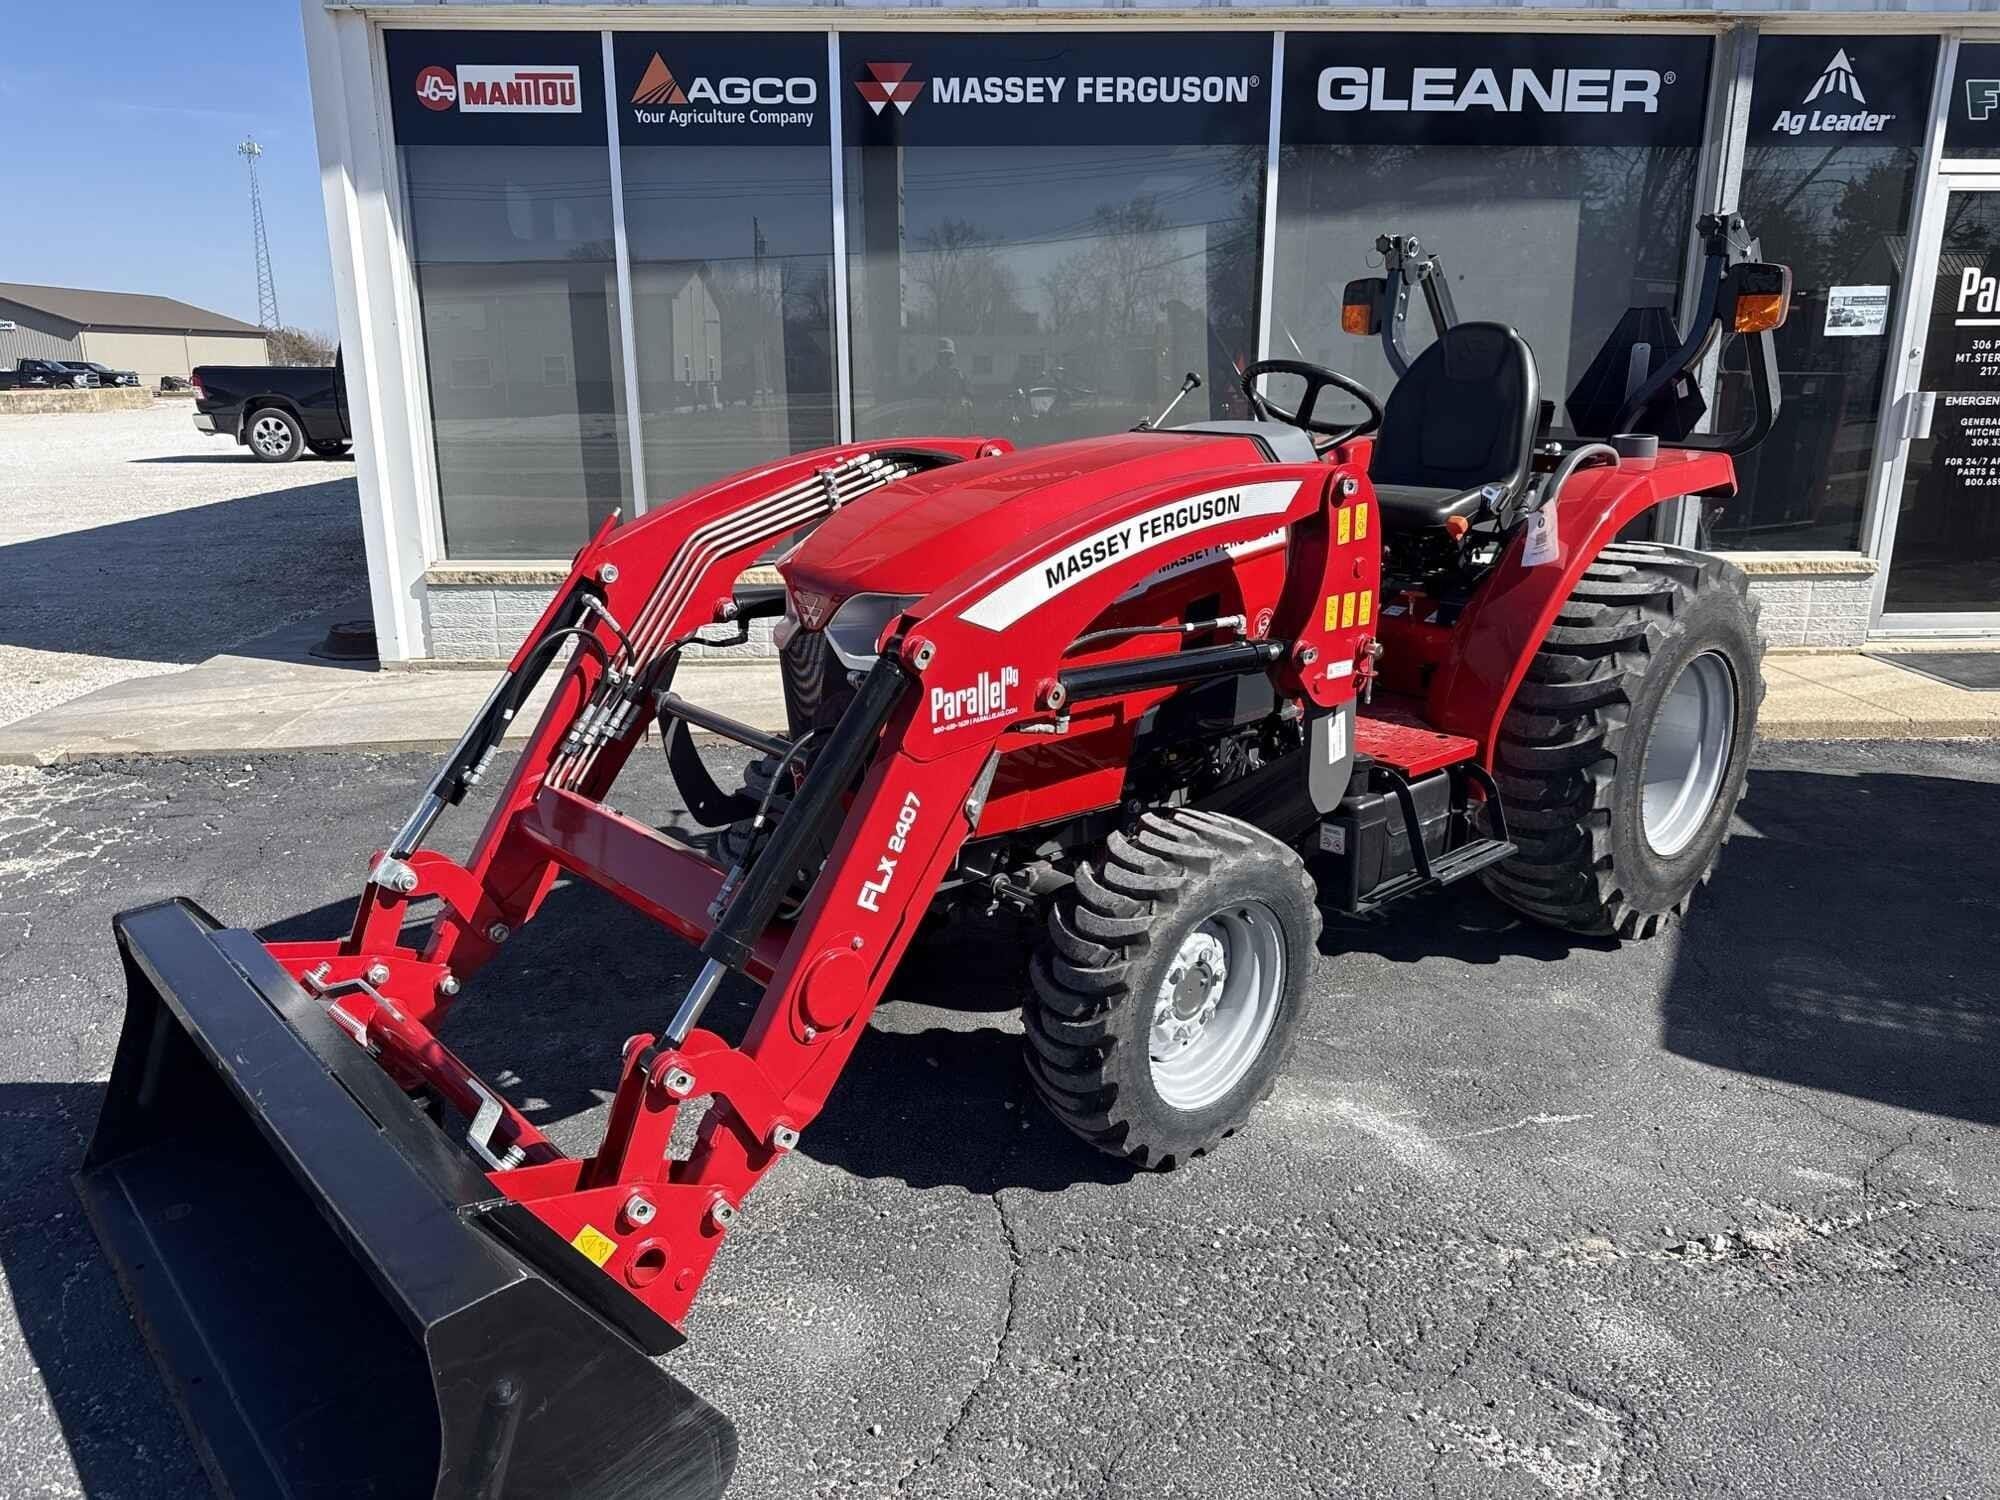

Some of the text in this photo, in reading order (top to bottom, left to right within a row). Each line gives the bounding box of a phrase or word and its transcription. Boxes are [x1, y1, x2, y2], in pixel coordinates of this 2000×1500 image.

[463, 72, 576, 106] MANITOU
[687, 76, 817, 104] AGCO
[932, 77, 1066, 103] MASSEY
[634, 109, 814, 127] Your Agriculture Company
[1772, 110, 1807, 135] Ag
[1972, 340, 1992, 350] 306
[1945, 396, 2000, 406] EMERGEN
[1944, 457, 1963, 466] FOR
[1965, 457, 1988, 466] 24/7
[1956, 467, 1986, 476] PARTS
[1045, 493, 1242, 589] MASSEY FERGUSON
[856, 791, 921, 912] FLX 2407
